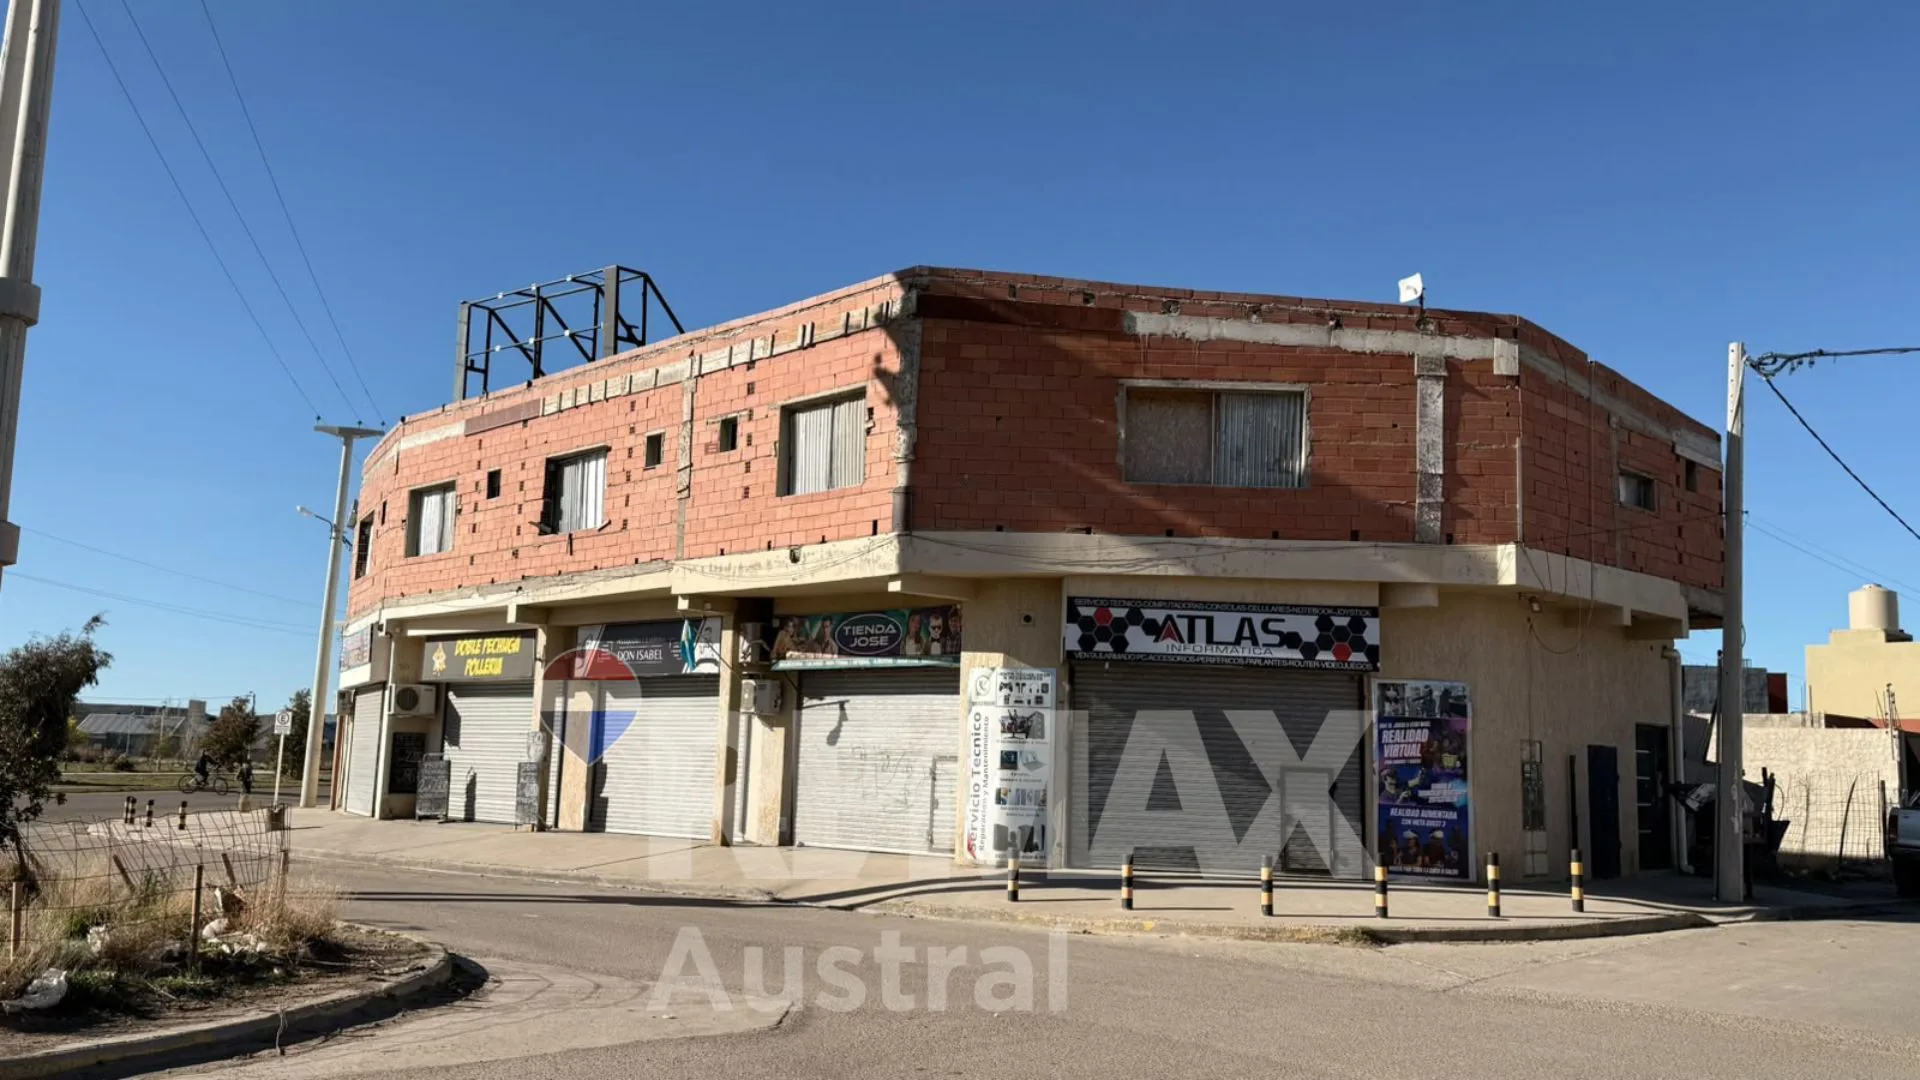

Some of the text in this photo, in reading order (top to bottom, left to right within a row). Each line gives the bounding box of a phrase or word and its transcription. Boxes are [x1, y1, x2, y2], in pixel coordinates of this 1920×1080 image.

[842, 623, 897, 636] TIENDA
[1154, 613, 1286, 648] ATLAS
[455, 639, 482, 656] DOBLE
[849, 636, 890, 647] JOSE
[617, 650, 635, 661] DON
[636, 649, 663, 661] ISABEL
[1166, 643, 1274, 657] INFORMATICA
[1382, 728, 1429, 744] REALIDAD
[1383, 743, 1422, 758] VIRTUAL
[967, 712, 982, 853] Servicio Tecnico
[1390, 808, 1420, 817] REALIDAD
